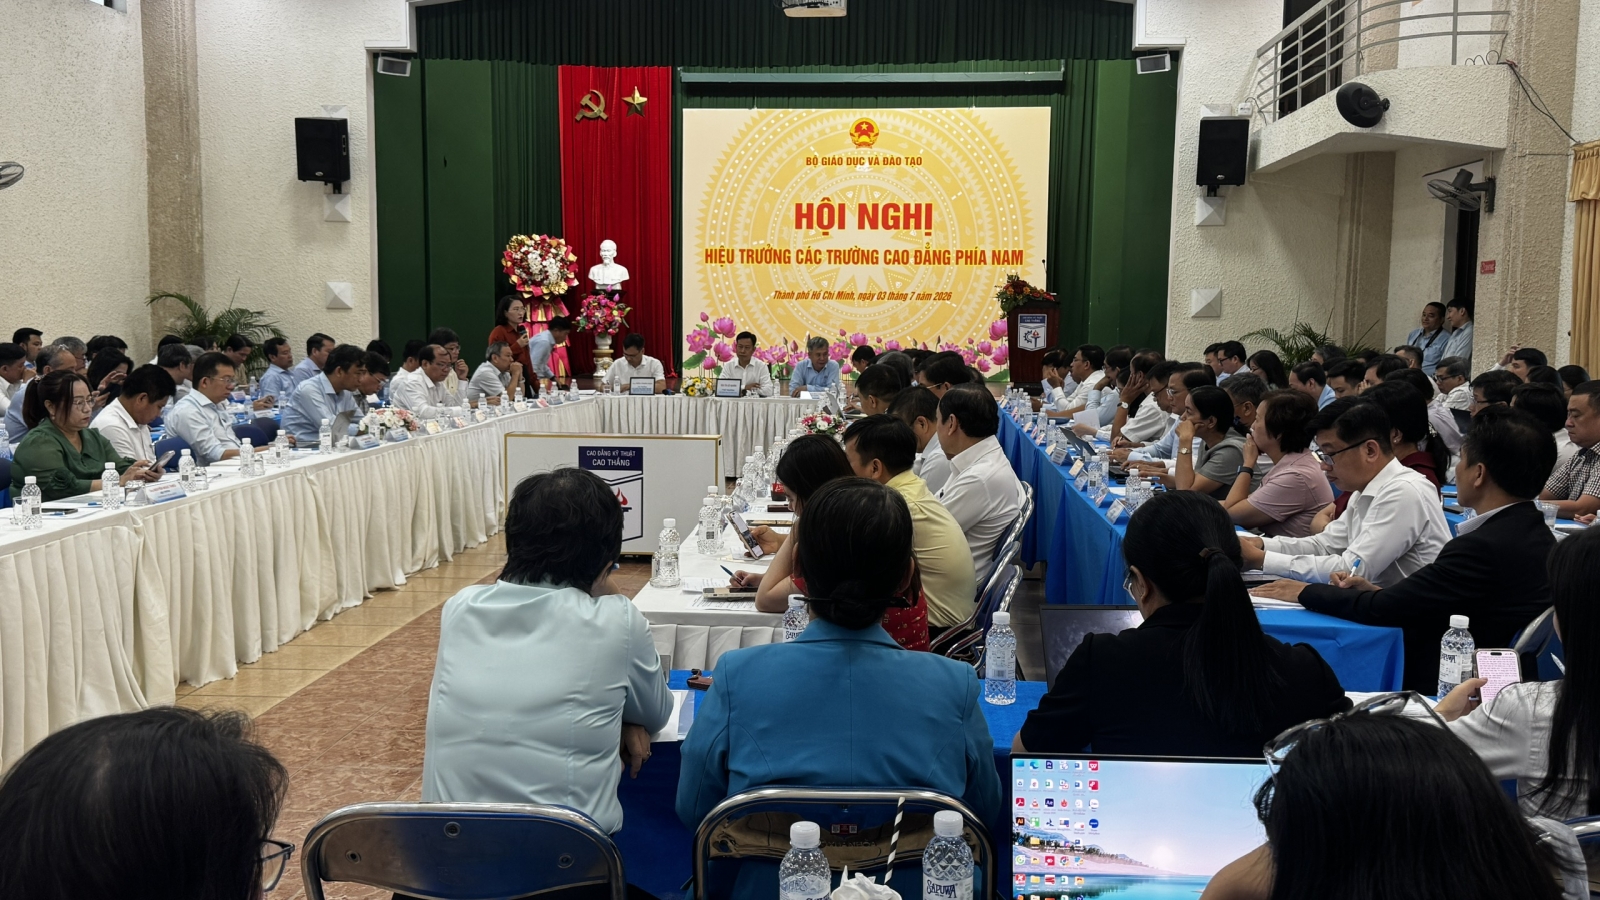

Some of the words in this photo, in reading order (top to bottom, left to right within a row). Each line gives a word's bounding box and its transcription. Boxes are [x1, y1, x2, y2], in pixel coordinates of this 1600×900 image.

[806, 154, 819, 168] BỘ
[821, 154, 843, 166] GIÁO
[846, 156, 865, 168] DỤC
[868, 154, 880, 166] VÀ
[883, 154, 902, 166] ĐÀO
[905, 156, 922, 168] TẠO
[795, 197, 846, 236] HỘI
[857, 202, 933, 236] NGHỊ
[705, 245, 735, 267] HIỆU
[739, 243, 791, 265] TRƯỞNG
[795, 245, 822, 265] CÁC
[826, 245, 879, 265] TRƯỜNG
[883, 249, 910, 265] CAO
[914, 242, 951, 265] ĐẲNG
[955, 246, 987, 265] PHÍA
[991, 249, 1024, 265] NAM
[773, 290, 795, 300] Thành
[795, 289, 812, 301] phố
[822, 290, 836, 300] Chí
[836, 290, 856, 301] Minh,
[857, 291, 876, 302] ngày
[876, 291, 887, 301] 03
[888, 291, 909, 302] tháng
[910, 291, 916, 301] 7
[915, 291, 933, 301] năm
[933, 291, 953, 301] 2026
[592, 458, 606, 466] CAO
[926, 879, 957, 899] SAPUWA
